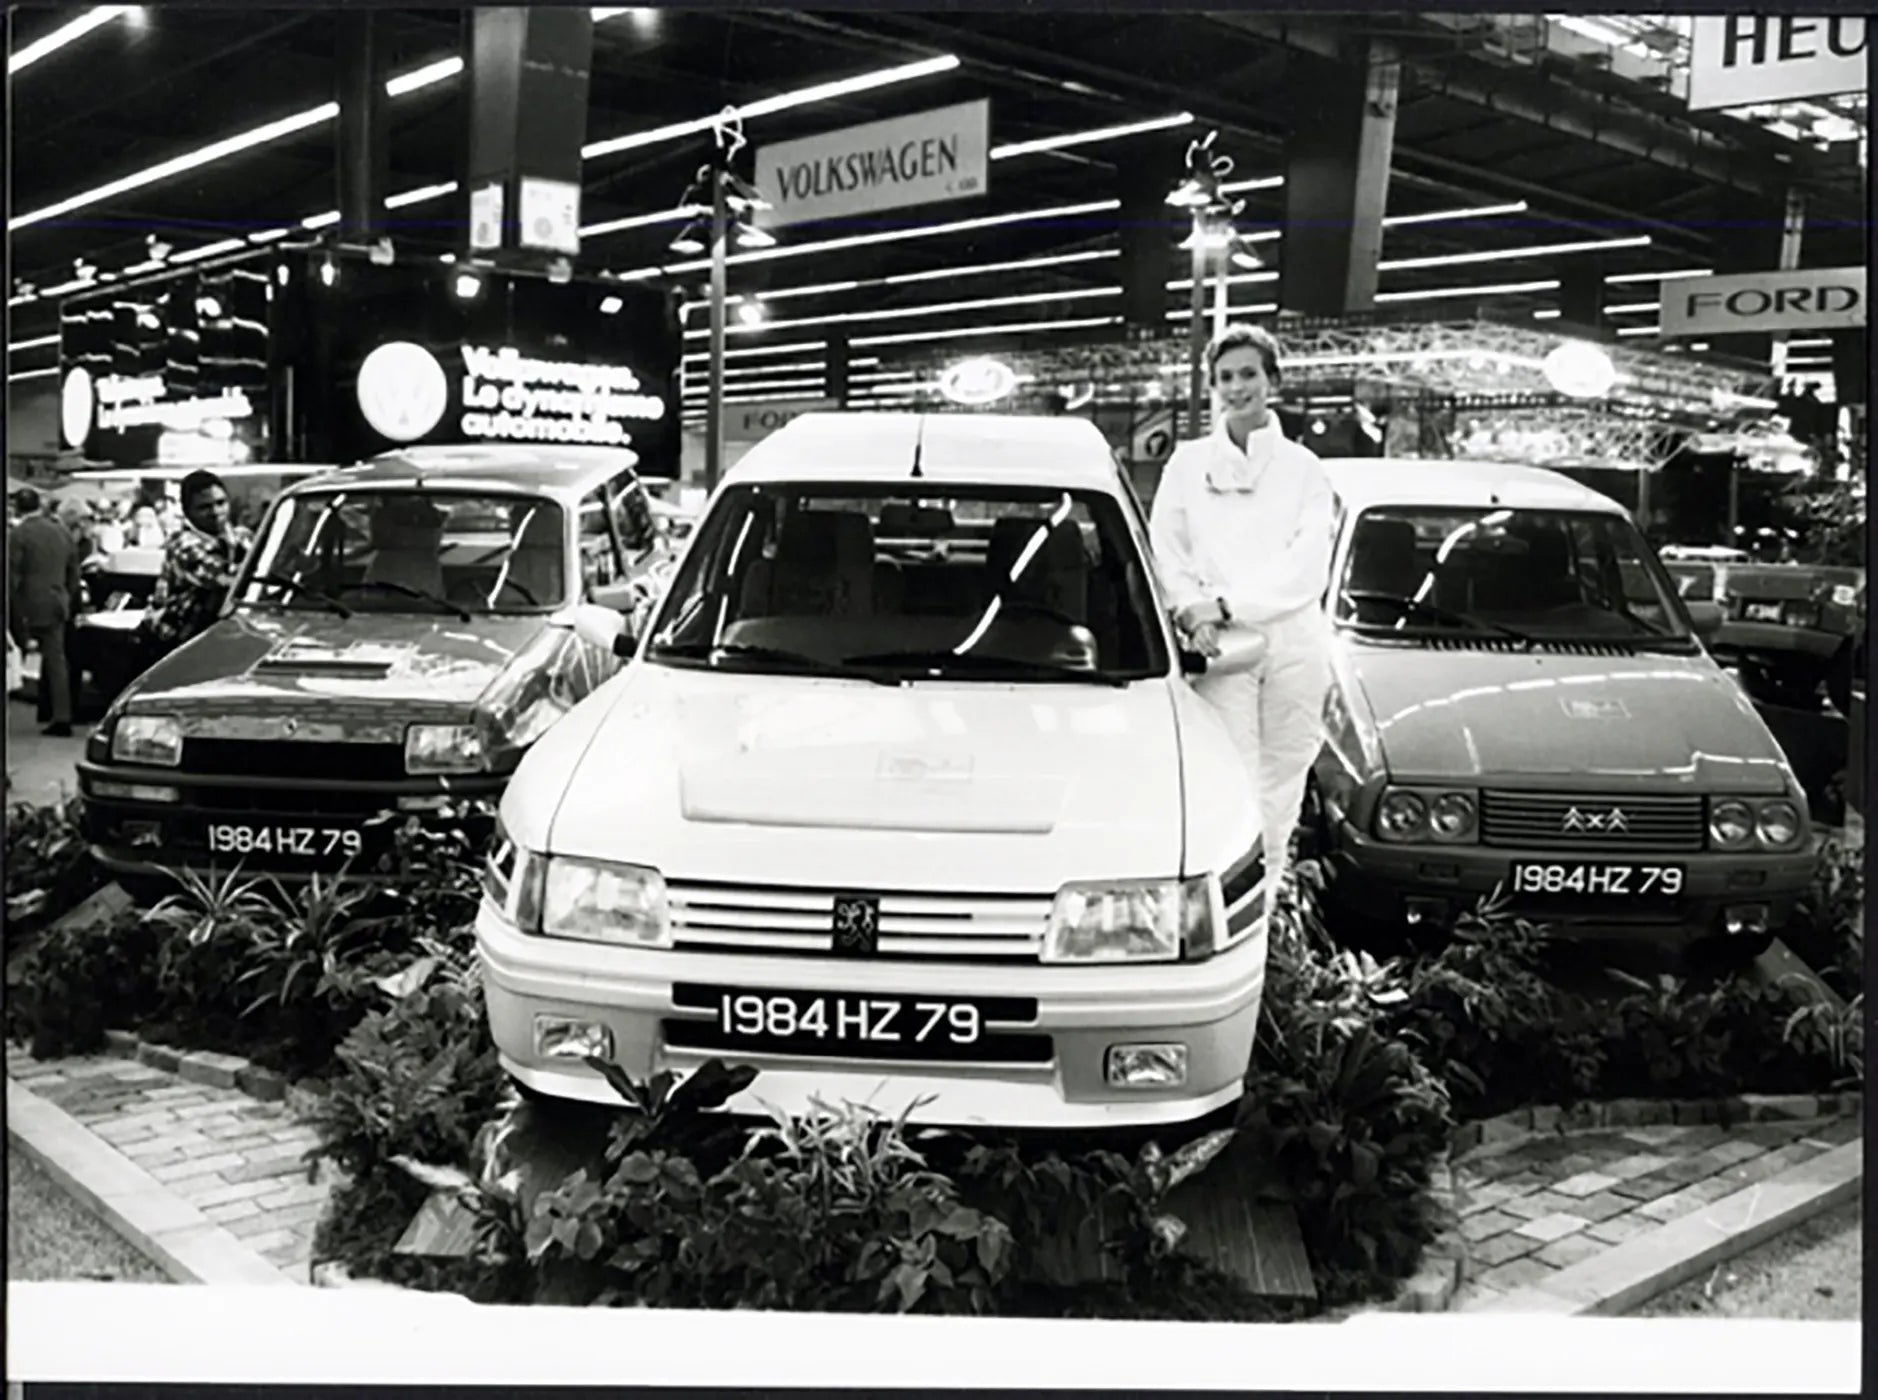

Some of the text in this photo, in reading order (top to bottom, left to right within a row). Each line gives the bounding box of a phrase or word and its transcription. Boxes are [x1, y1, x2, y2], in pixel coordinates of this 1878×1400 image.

[776, 134, 958, 202] VOLKSWAGEN
[1687, 286, 1860, 318] FORD
[462, 374, 501, 408] Le
[461, 411, 633, 445] automobile.
[208, 824, 363, 857] 1984 HZ 79
[1514, 864, 1683, 895] 1984 HZ 79
[722, 994, 979, 1044] 1984 HZ 79
